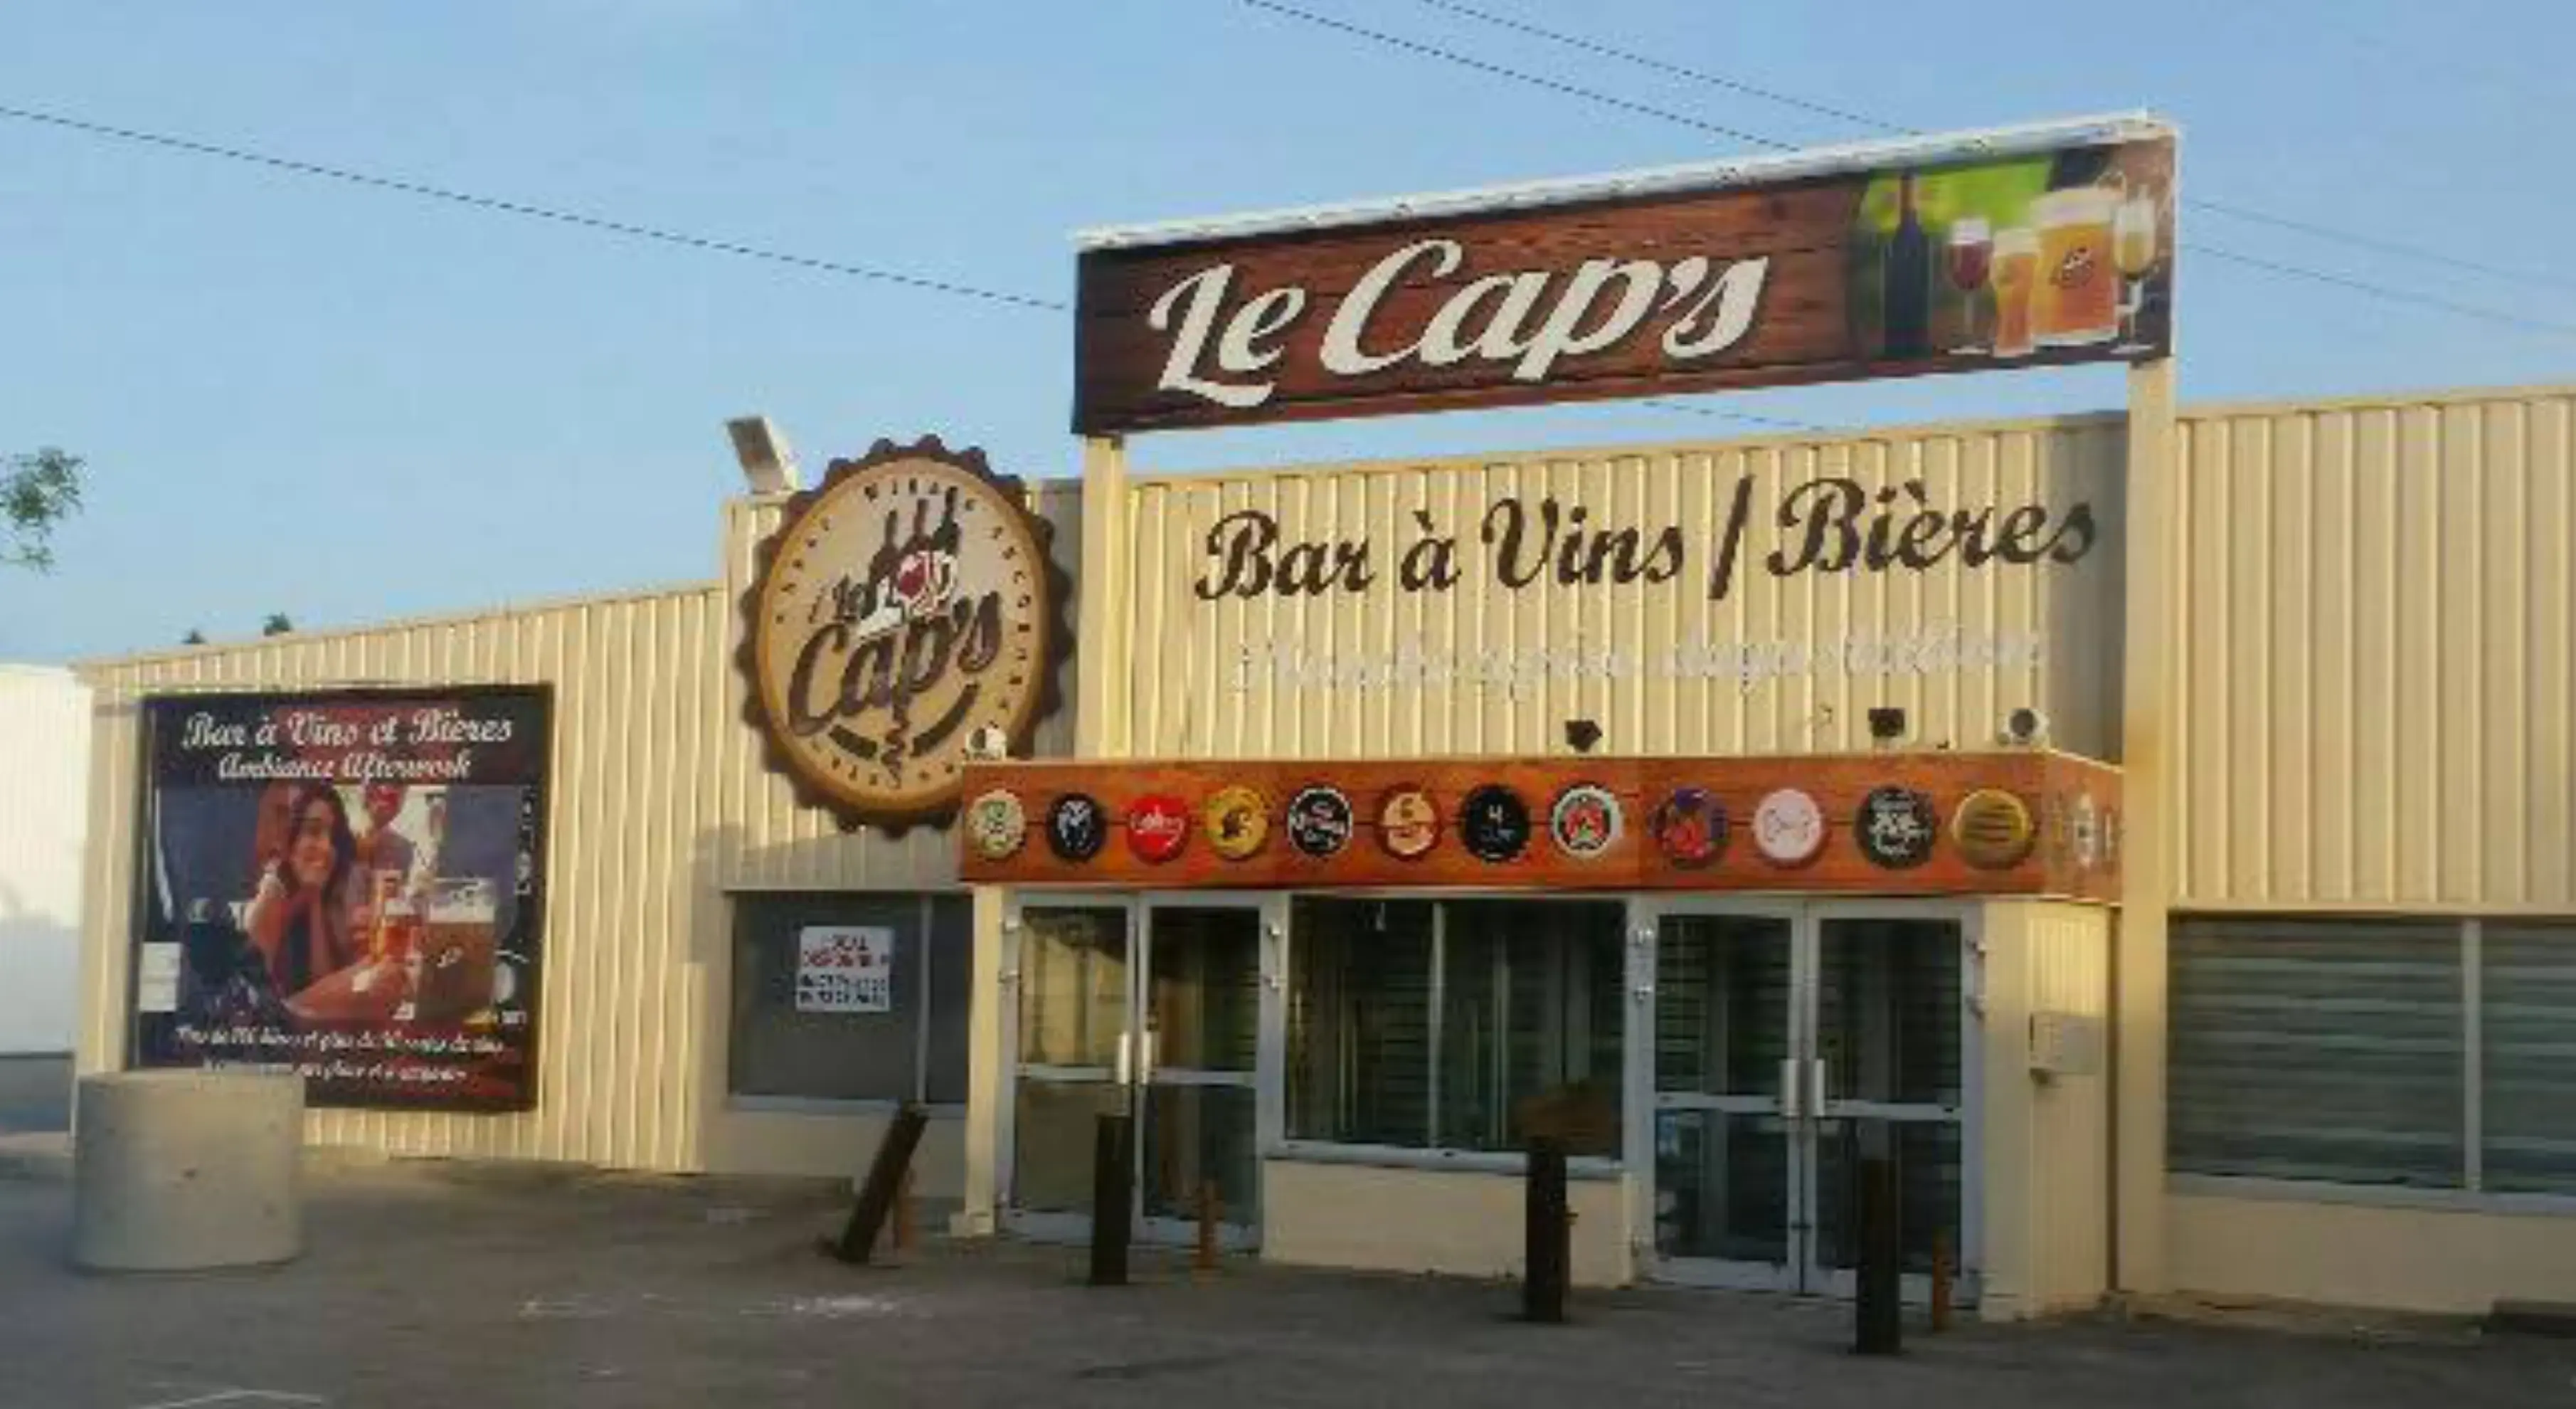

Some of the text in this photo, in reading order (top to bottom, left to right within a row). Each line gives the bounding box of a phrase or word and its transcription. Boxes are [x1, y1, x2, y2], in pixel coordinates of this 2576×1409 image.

[1147, 238, 1770, 408] Le Cap's
[1194, 508, 1374, 599] Bar
[1399, 510, 1461, 593] à
[1481, 495, 1685, 589] Vins
[1767, 476, 2097, 576] Bières
[788, 589, 1004, 739] Cap's
[180, 709, 514, 749] Bar à Vins et Bières
[218, 748, 472, 783] Ambiance Afterwork
